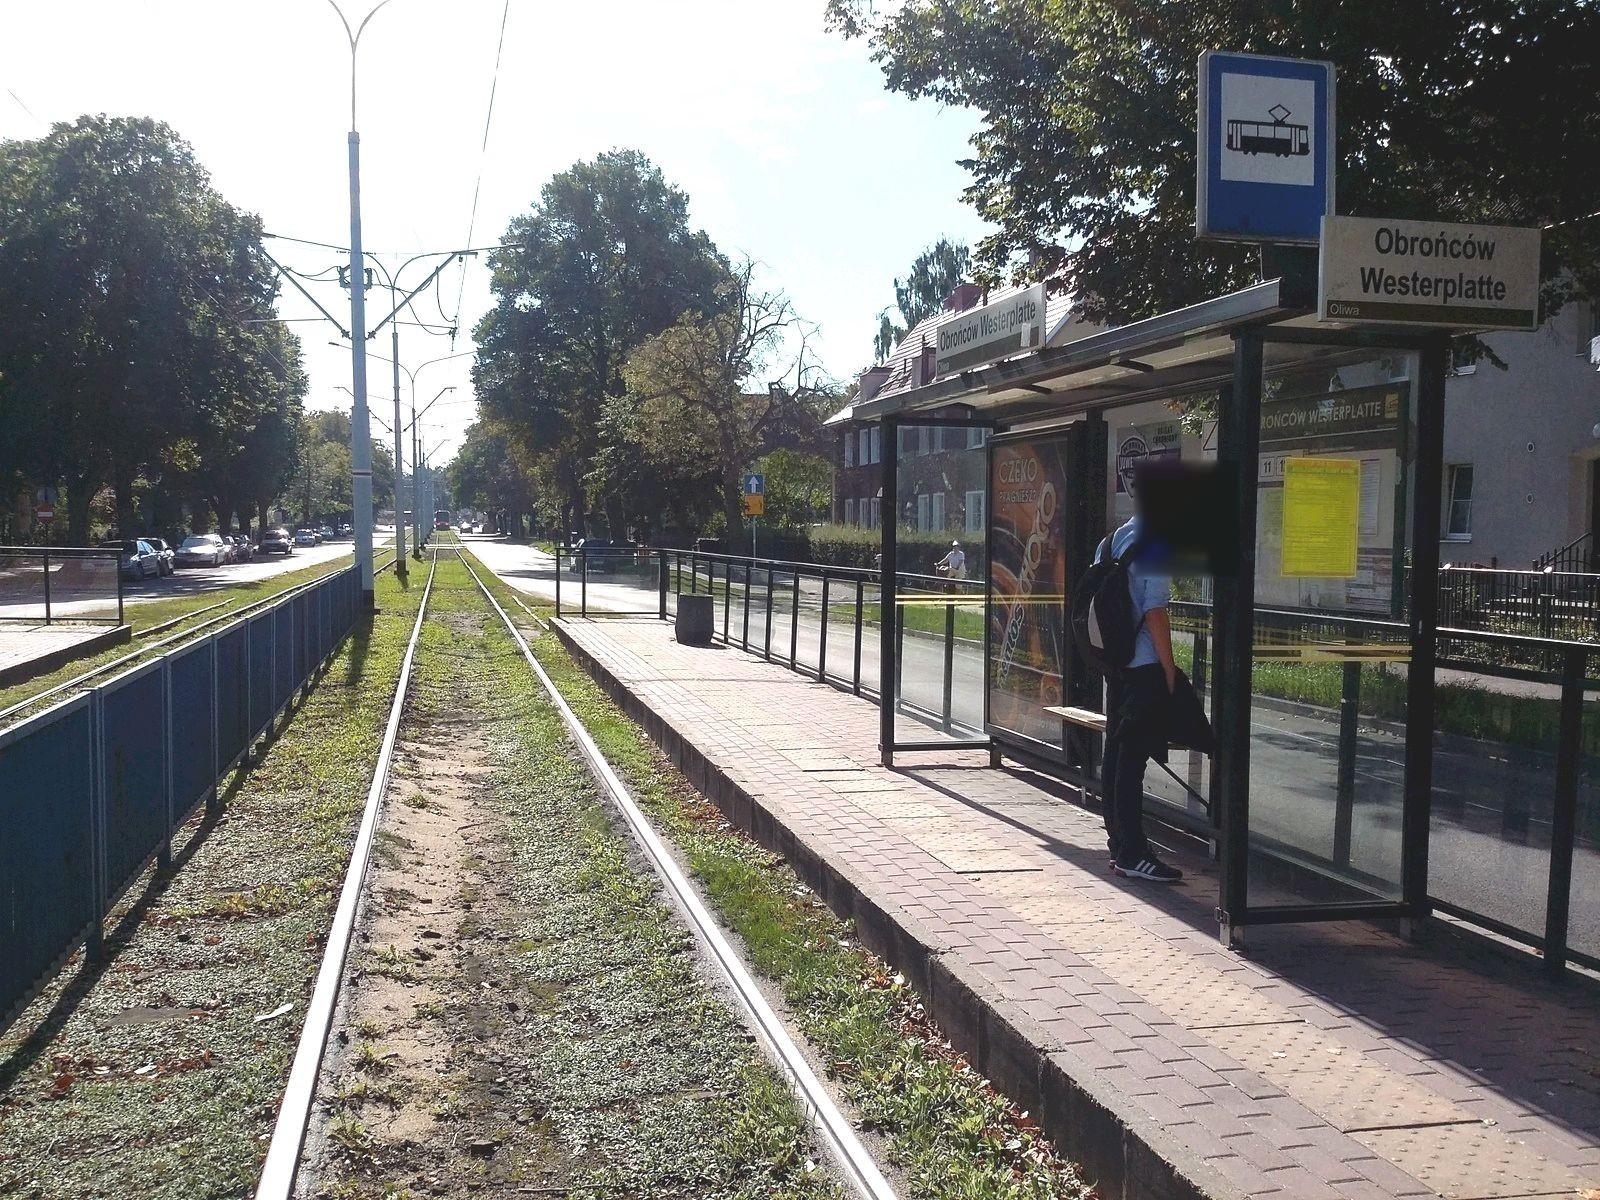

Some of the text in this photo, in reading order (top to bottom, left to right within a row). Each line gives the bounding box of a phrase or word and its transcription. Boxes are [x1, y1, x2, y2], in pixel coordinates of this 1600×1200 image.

[1374, 227, 1496, 262] Obrońców
[1360, 266, 1507, 304] Westerplatte
[1329, 303, 1360, 316] Oliwa
[940, 300, 1036, 352] Obrońców Westerplatte
[1309, 401, 1381, 424] WESTERPLATTE
[999, 457, 1038, 484] CZEKO
